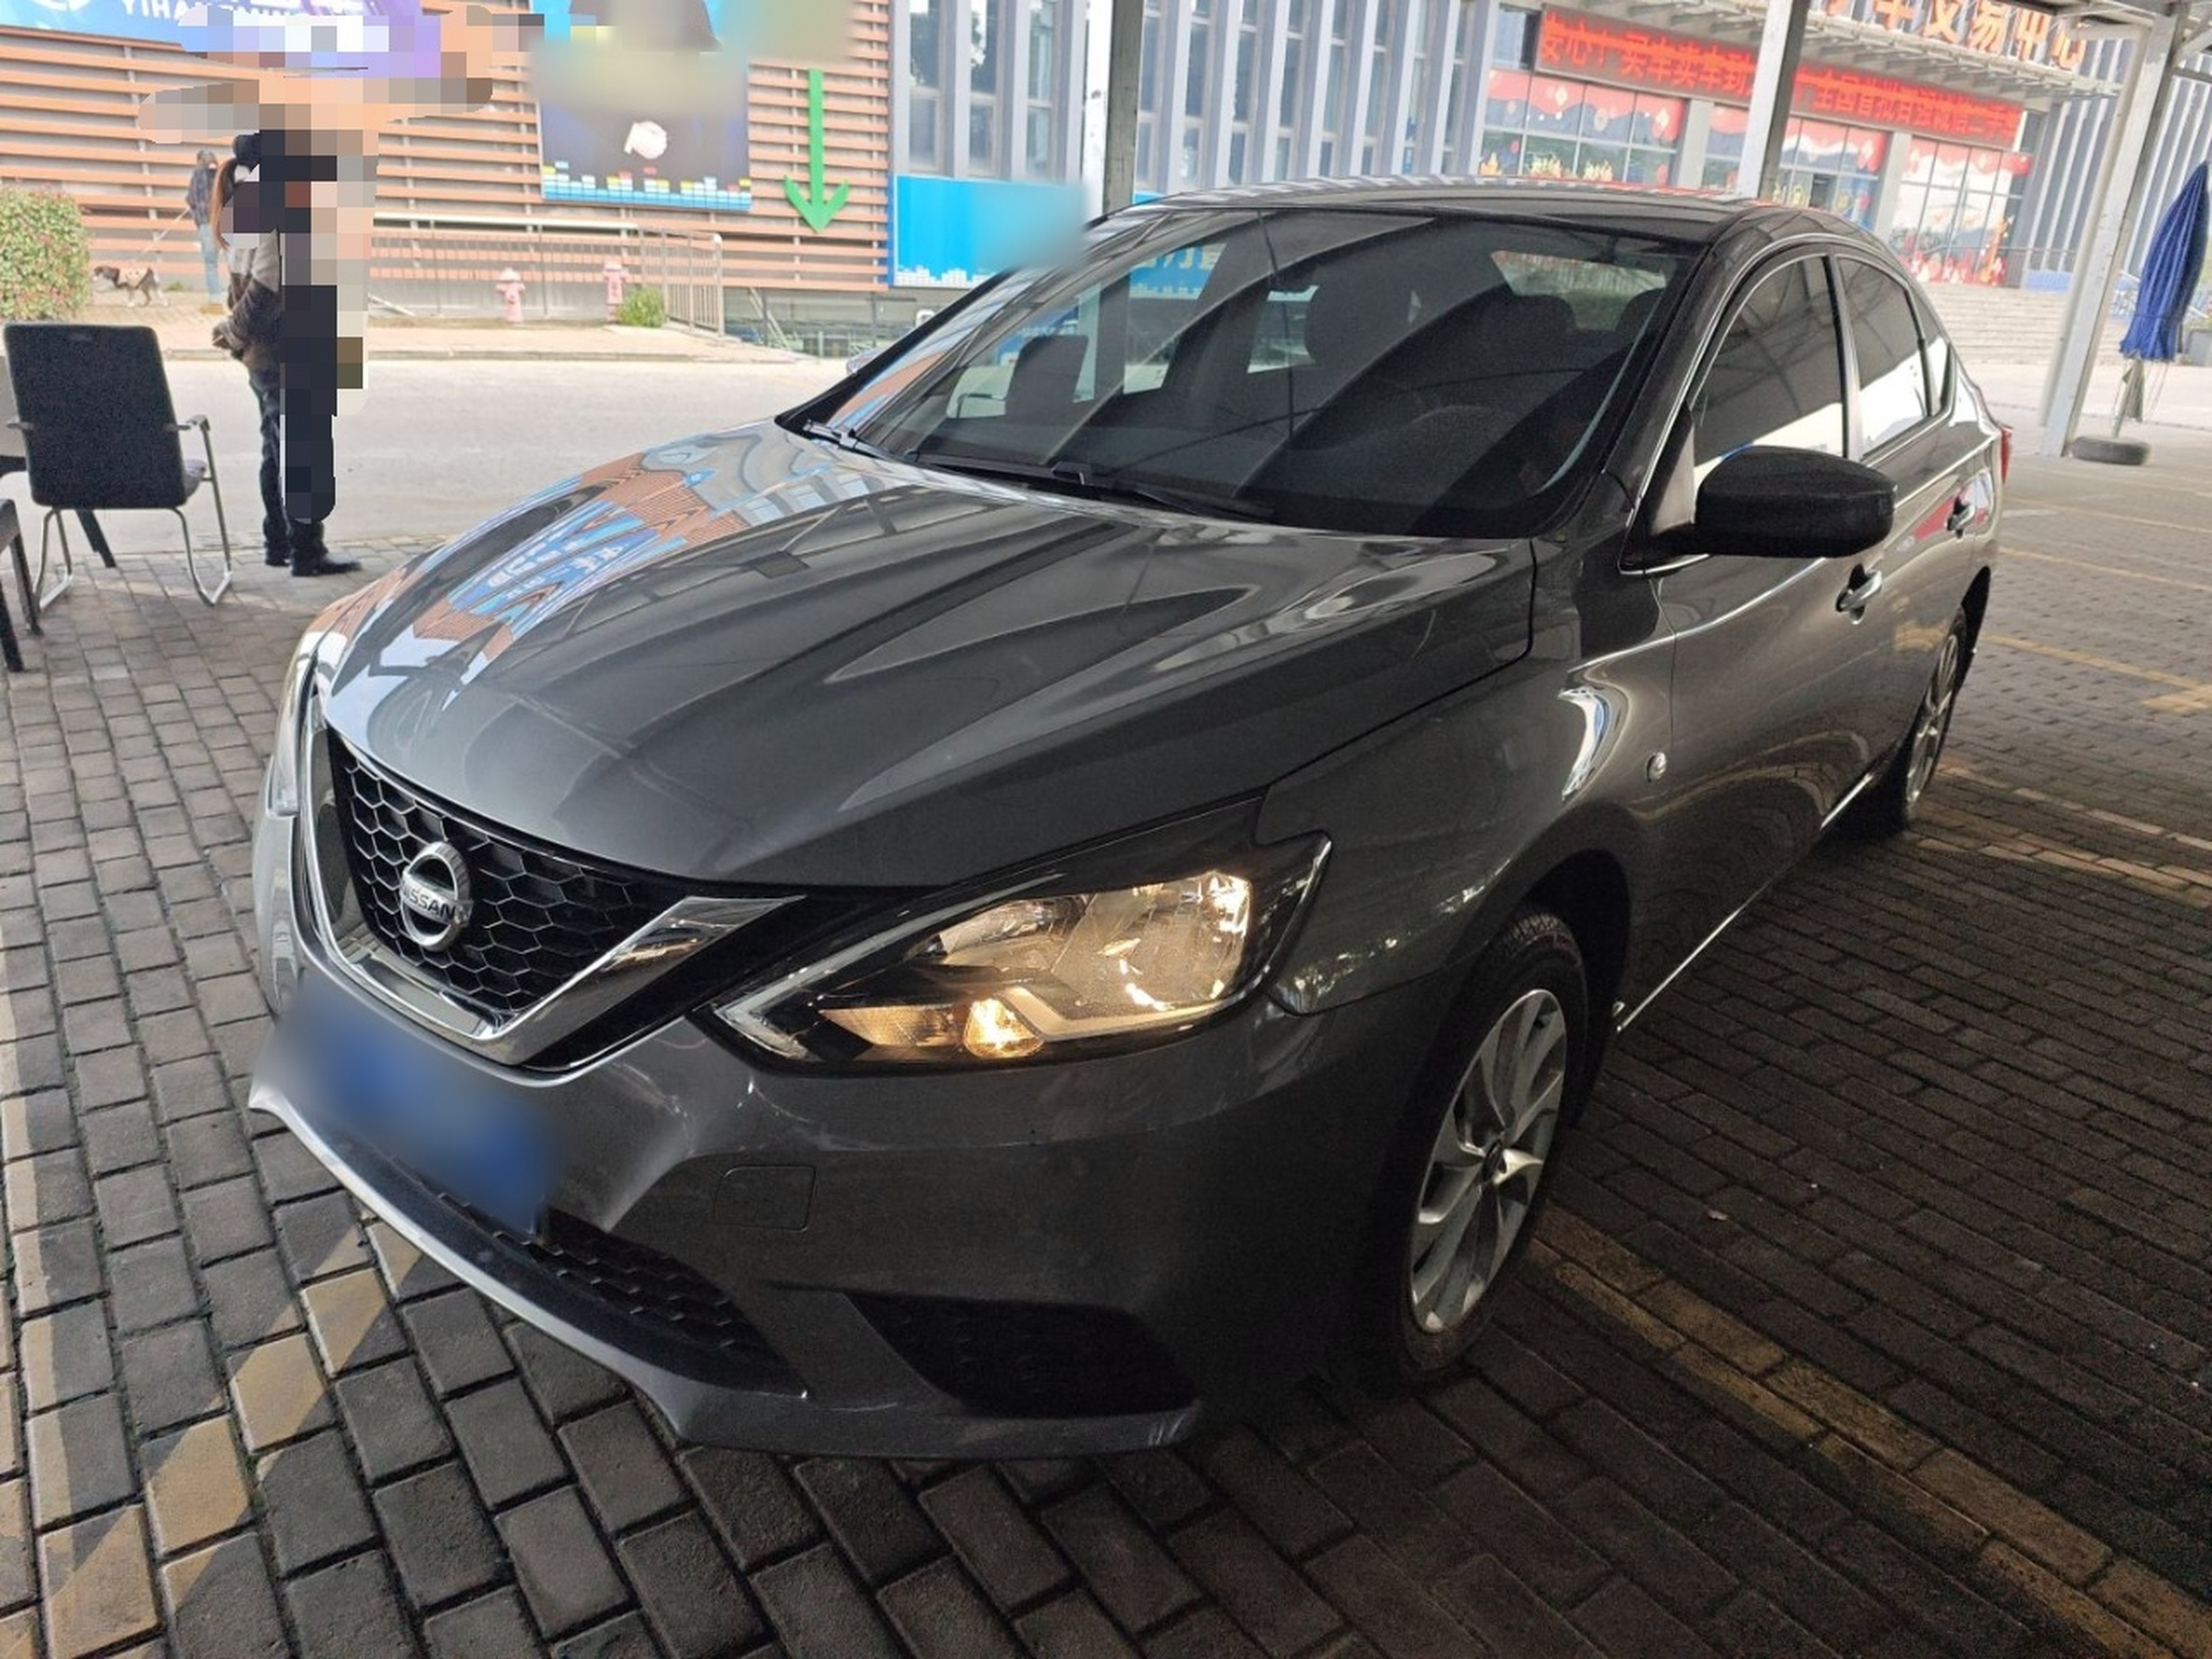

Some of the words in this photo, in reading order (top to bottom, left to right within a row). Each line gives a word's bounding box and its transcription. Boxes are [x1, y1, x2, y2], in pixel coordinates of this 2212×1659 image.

[1825, 0, 2086, 70] 车交易中心
